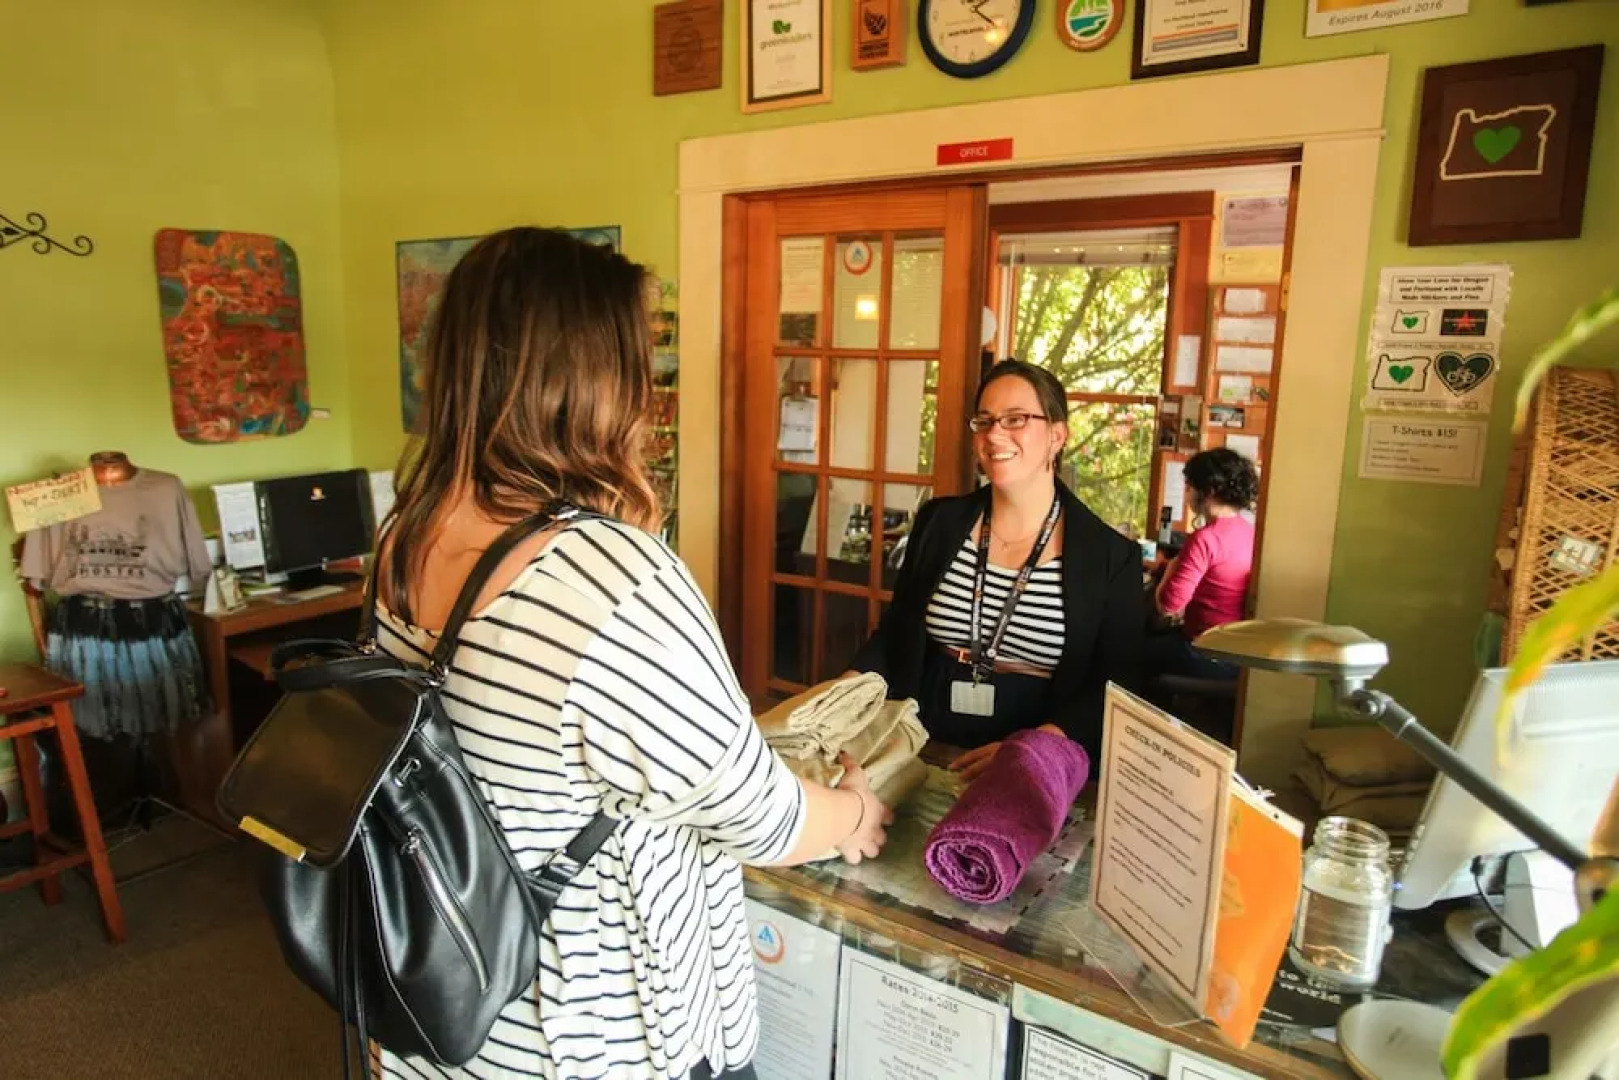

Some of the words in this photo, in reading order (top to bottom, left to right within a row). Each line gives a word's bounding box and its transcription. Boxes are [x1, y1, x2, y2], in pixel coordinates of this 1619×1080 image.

[1329, 12, 1369, 27] Expires
[1371, 6, 1413, 20] August
[1415, 2, 1443, 13] 2016
[959, 145, 989, 158] OFFICE
[1392, 425, 1433, 437] T-Shirts
[1125, 725, 1161, 754] CHECK-IN
[881, 975, 910, 995] Rates
